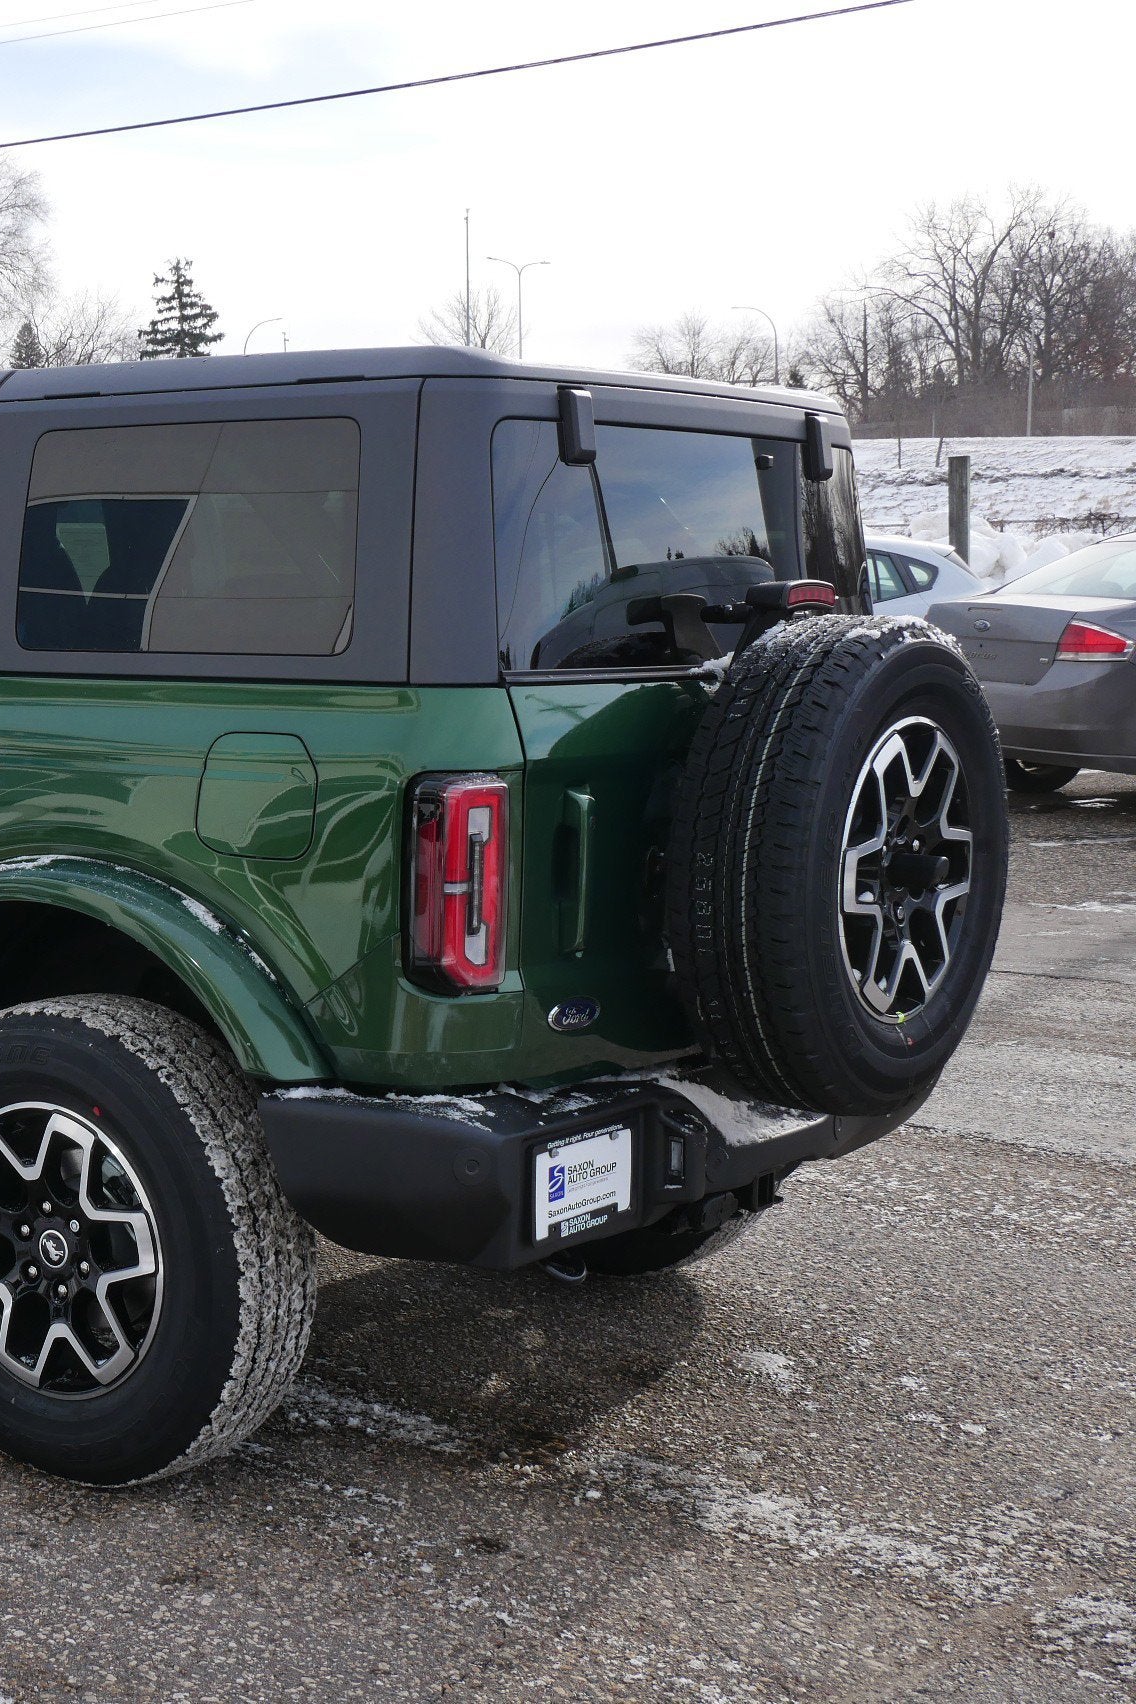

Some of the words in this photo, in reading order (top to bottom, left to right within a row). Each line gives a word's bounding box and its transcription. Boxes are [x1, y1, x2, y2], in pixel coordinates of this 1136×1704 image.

[562, 1007, 590, 1025] Ford
[583, 1131, 595, 1139] Four
[567, 1159, 594, 1176] SAXON
[567, 1170, 588, 1185] AUTO
[589, 1161, 617, 1178] GROUP
[548, 1190, 617, 1219] SaxonAutoGroup.com
[568, 1213, 591, 1227] SAXON
[568, 1223, 586, 1235] AUTO
[586, 1214, 608, 1229] GROUP
